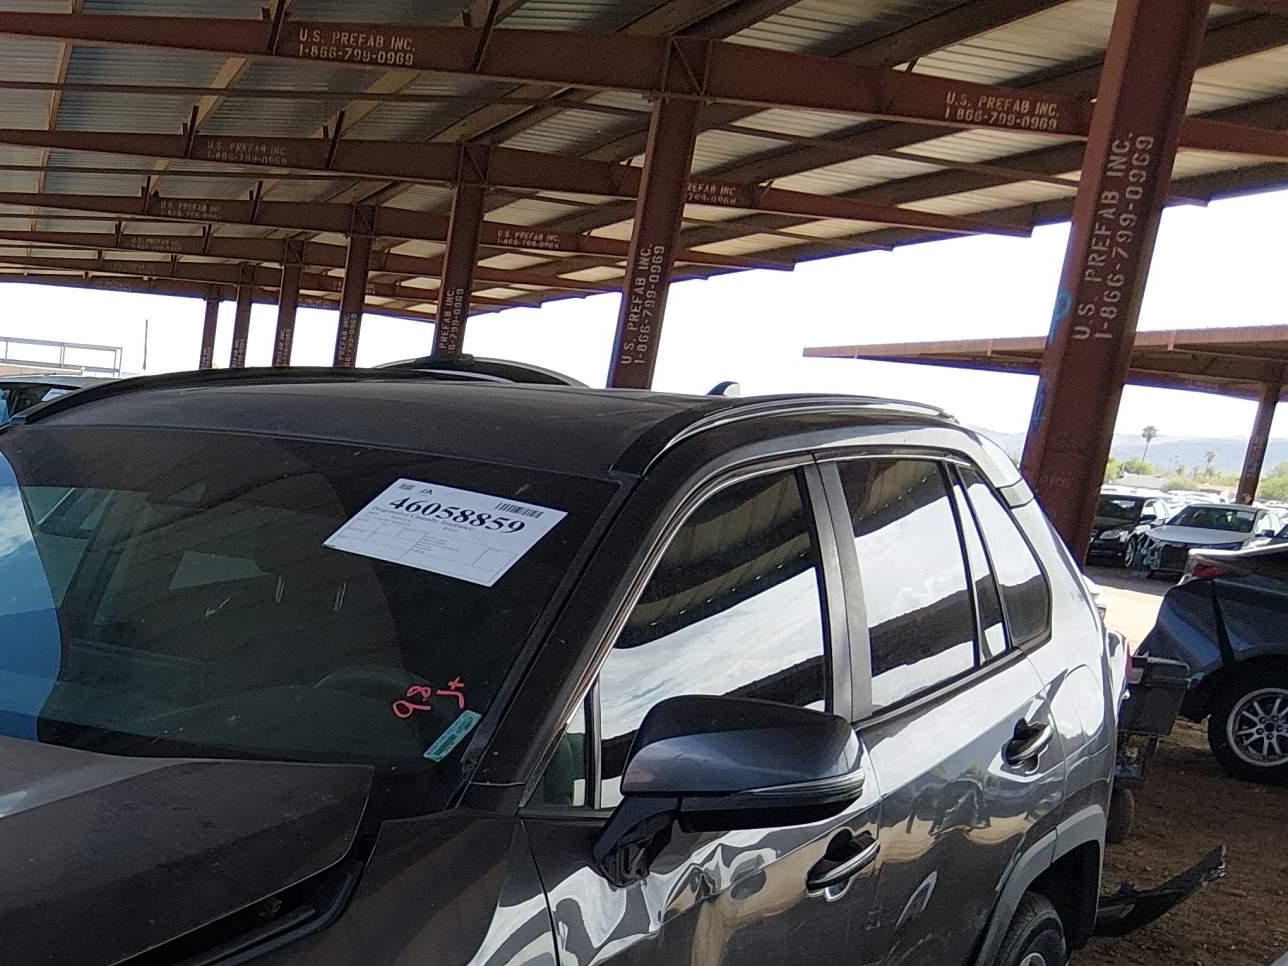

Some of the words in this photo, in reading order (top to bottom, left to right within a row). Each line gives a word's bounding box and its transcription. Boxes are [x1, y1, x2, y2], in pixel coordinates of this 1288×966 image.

[298, 44, 414, 66] 1-866-799-0969
[299, 28, 324, 43] U.S.
[332, 31, 384, 48] PREFAB
[390, 36, 416, 51] INC.
[946, 91, 972, 107] U.S.
[977, 96, 1030, 114] PREFAB
[1034, 102, 1060, 117] INC.
[1072, 296, 1098, 340] U.S.
[1085, 191, 1120, 282] PREFAB
[1106, 133, 1134, 177] INC.
[1095, 136, 1154, 338] 1-866-799-0969
[637, 243, 654, 271] INC.
[627, 277, 647, 331] PREFAB
[634, 245, 665, 365] 1-866-799-0969
[620, 338, 637, 365] U.S.
[388, 496, 526, 534] 46058859
